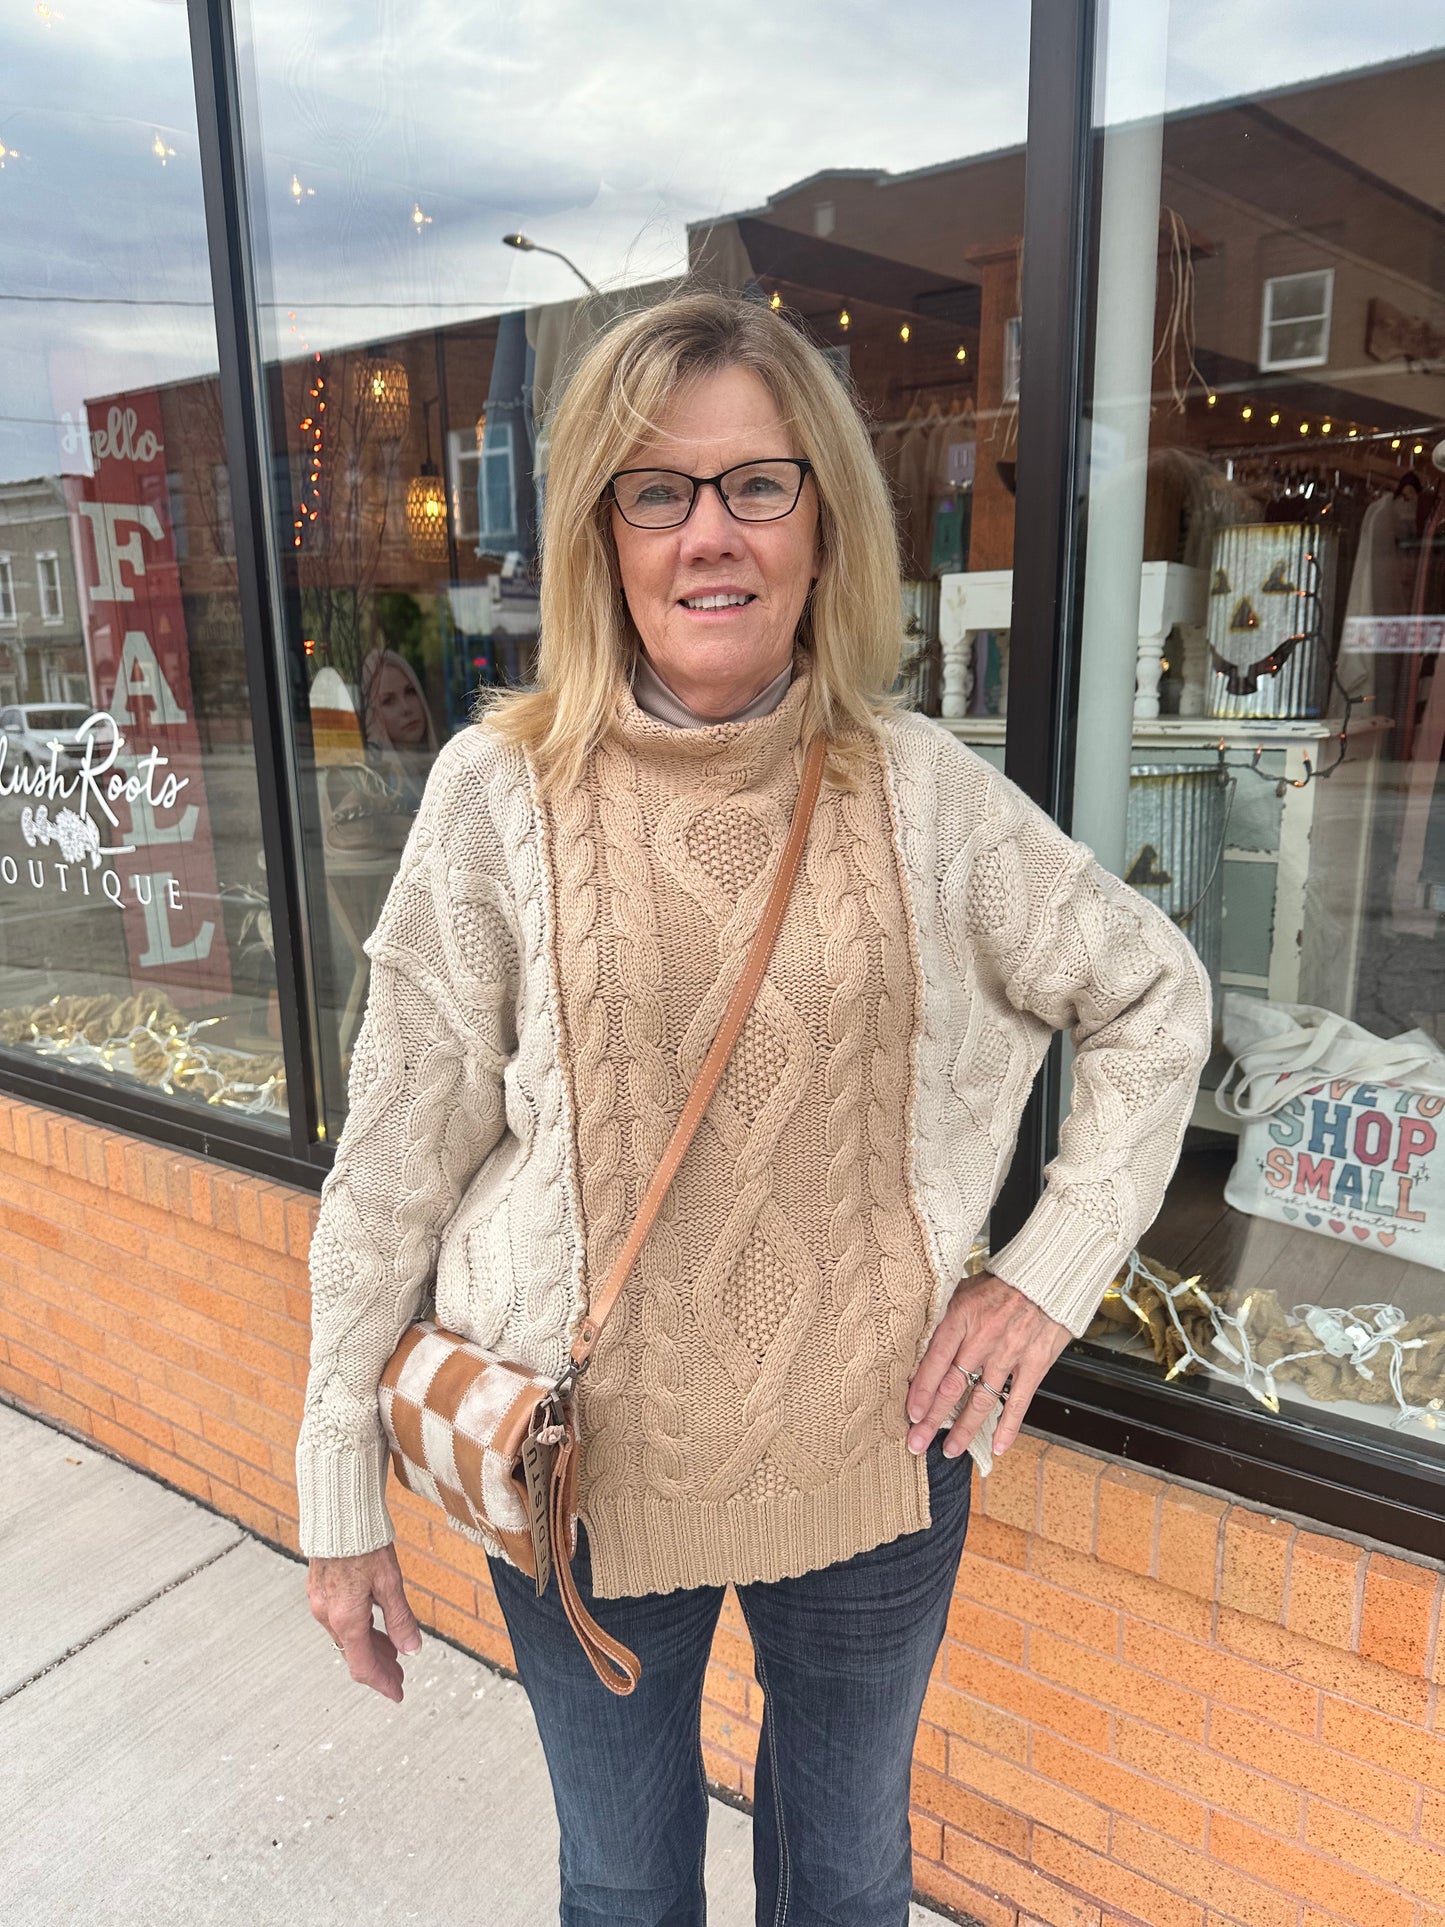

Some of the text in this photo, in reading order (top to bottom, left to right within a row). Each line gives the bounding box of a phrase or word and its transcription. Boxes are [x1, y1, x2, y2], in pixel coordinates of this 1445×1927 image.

[61, 406, 165, 478] Hello
[0, 735, 80, 801] lush
[78, 501, 215, 968] FALL
[0, 855, 184, 910] OUTIQUE
[1267, 1097, 1437, 1174] SHOP
[1264, 1146, 1427, 1222] SMALL
[1345, 1210, 1422, 1236] boutique
